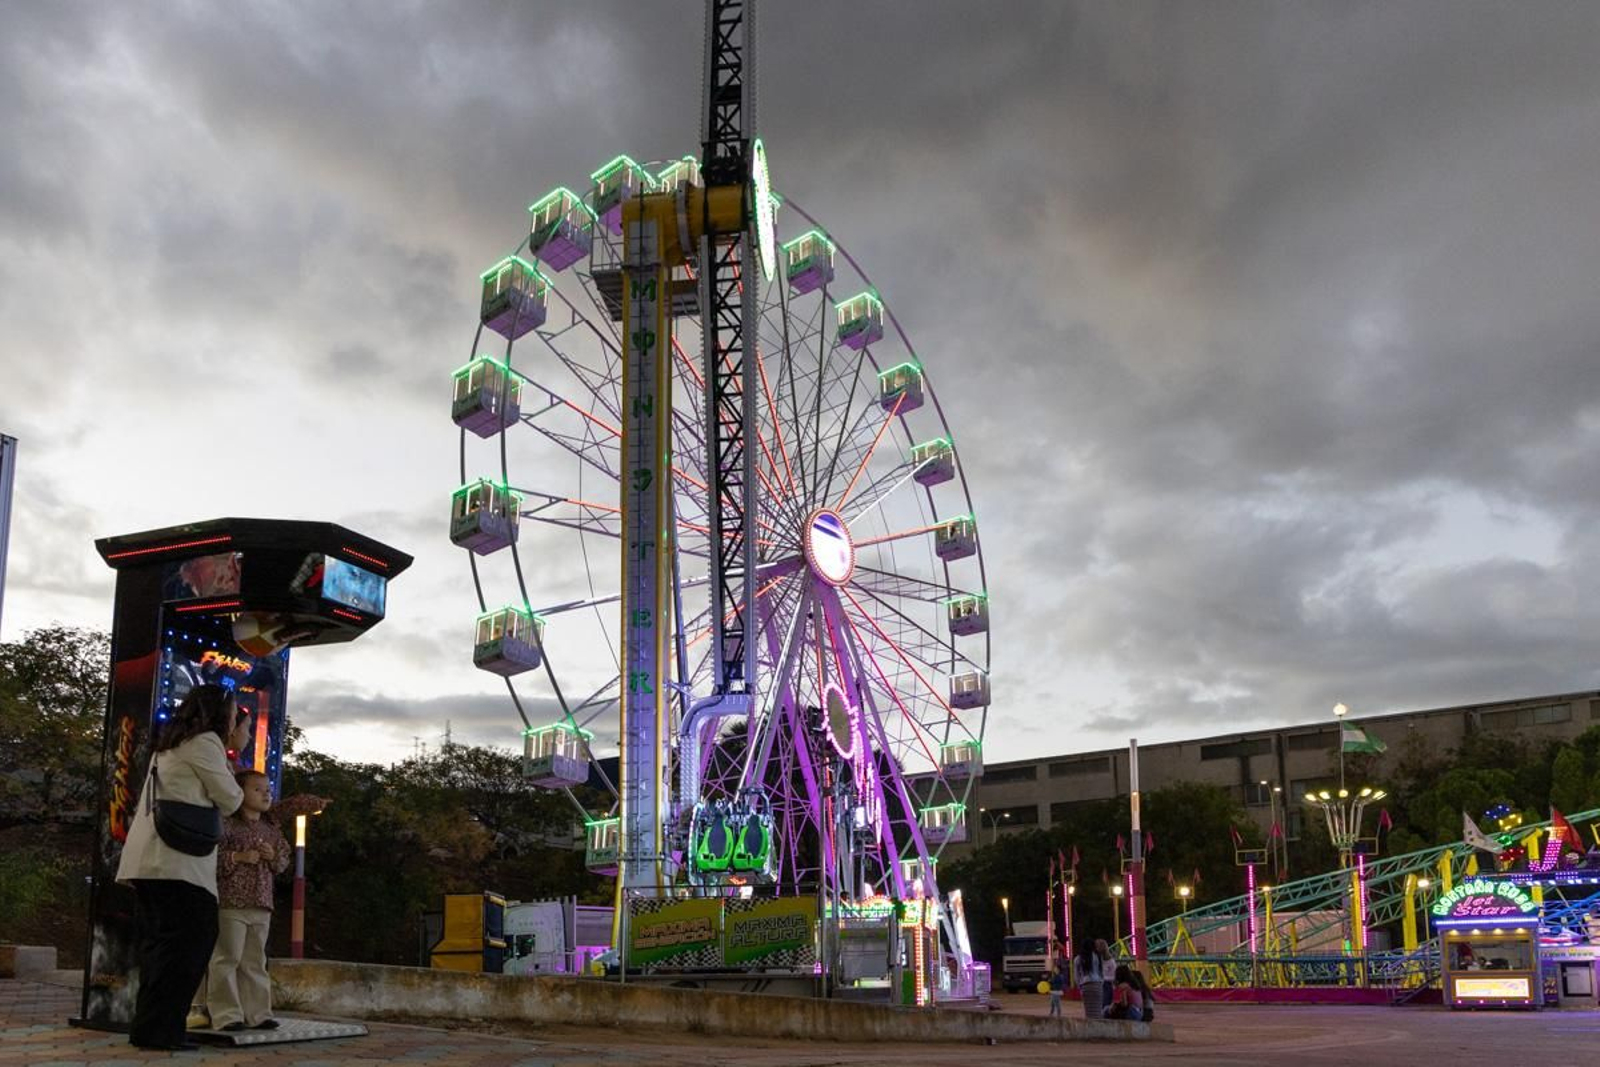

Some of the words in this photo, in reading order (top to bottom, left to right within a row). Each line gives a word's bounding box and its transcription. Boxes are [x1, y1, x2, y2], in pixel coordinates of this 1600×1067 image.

[1497, 882, 1536, 912] RUSA
[1453, 904, 1517, 916] Star
[729, 927, 810, 948] ALTURA
